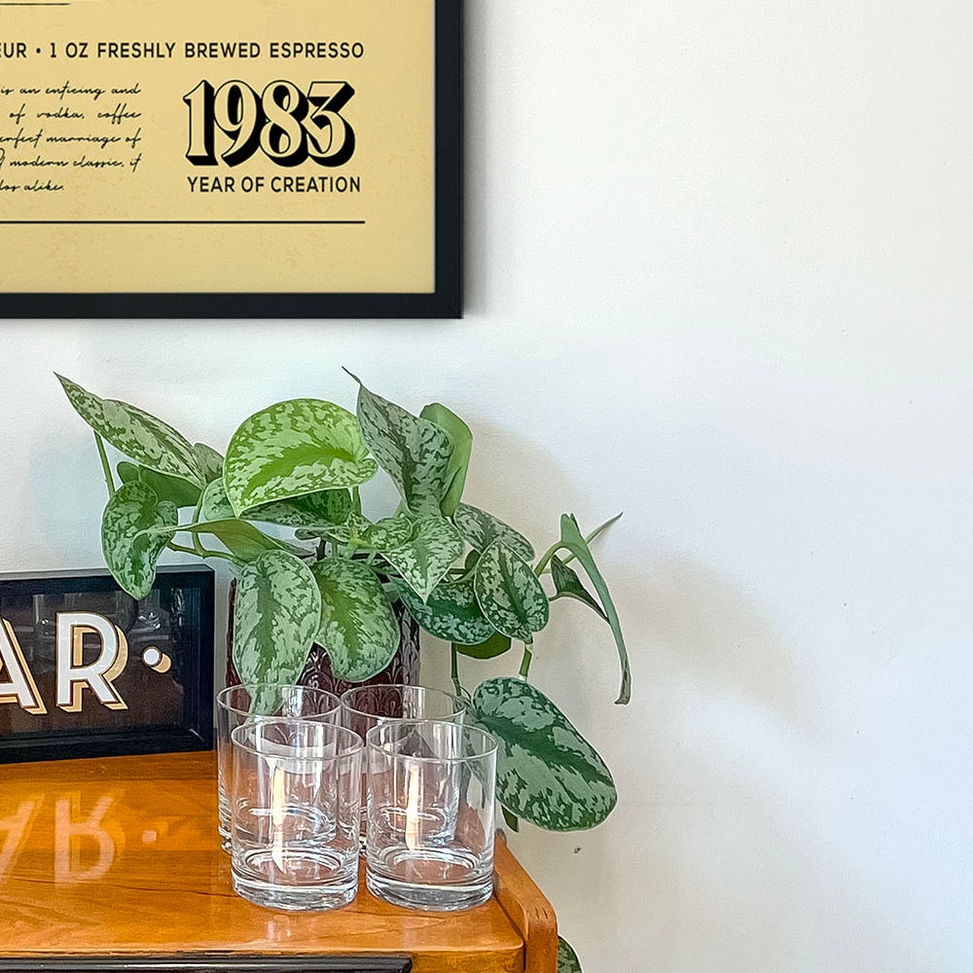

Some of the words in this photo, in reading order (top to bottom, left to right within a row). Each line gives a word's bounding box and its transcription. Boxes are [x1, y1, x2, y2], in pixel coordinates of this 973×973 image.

[49, 42, 58, 59] 1
[65, 42, 89, 59] OZ
[97, 41, 176, 59] FRESHLY
[184, 42, 261, 59] BREWED
[269, 41, 364, 59] ESPRESSO
[0, 86, 15, 96] is
[45, 80, 106, 101] enticing
[110, 82, 142, 95] and
[9, 102, 26, 125] of
[97, 102, 142, 125] coffee
[182, 79, 356, 169] 1983
[45, 136, 122, 150] marriage
[124, 127, 142, 149] of
[9, 155, 69, 167] modern
[129, 152, 142, 173] it
[186, 176, 236, 193] YEAR
[240, 175, 266, 193] OF
[270, 176, 361, 193] CREATION
